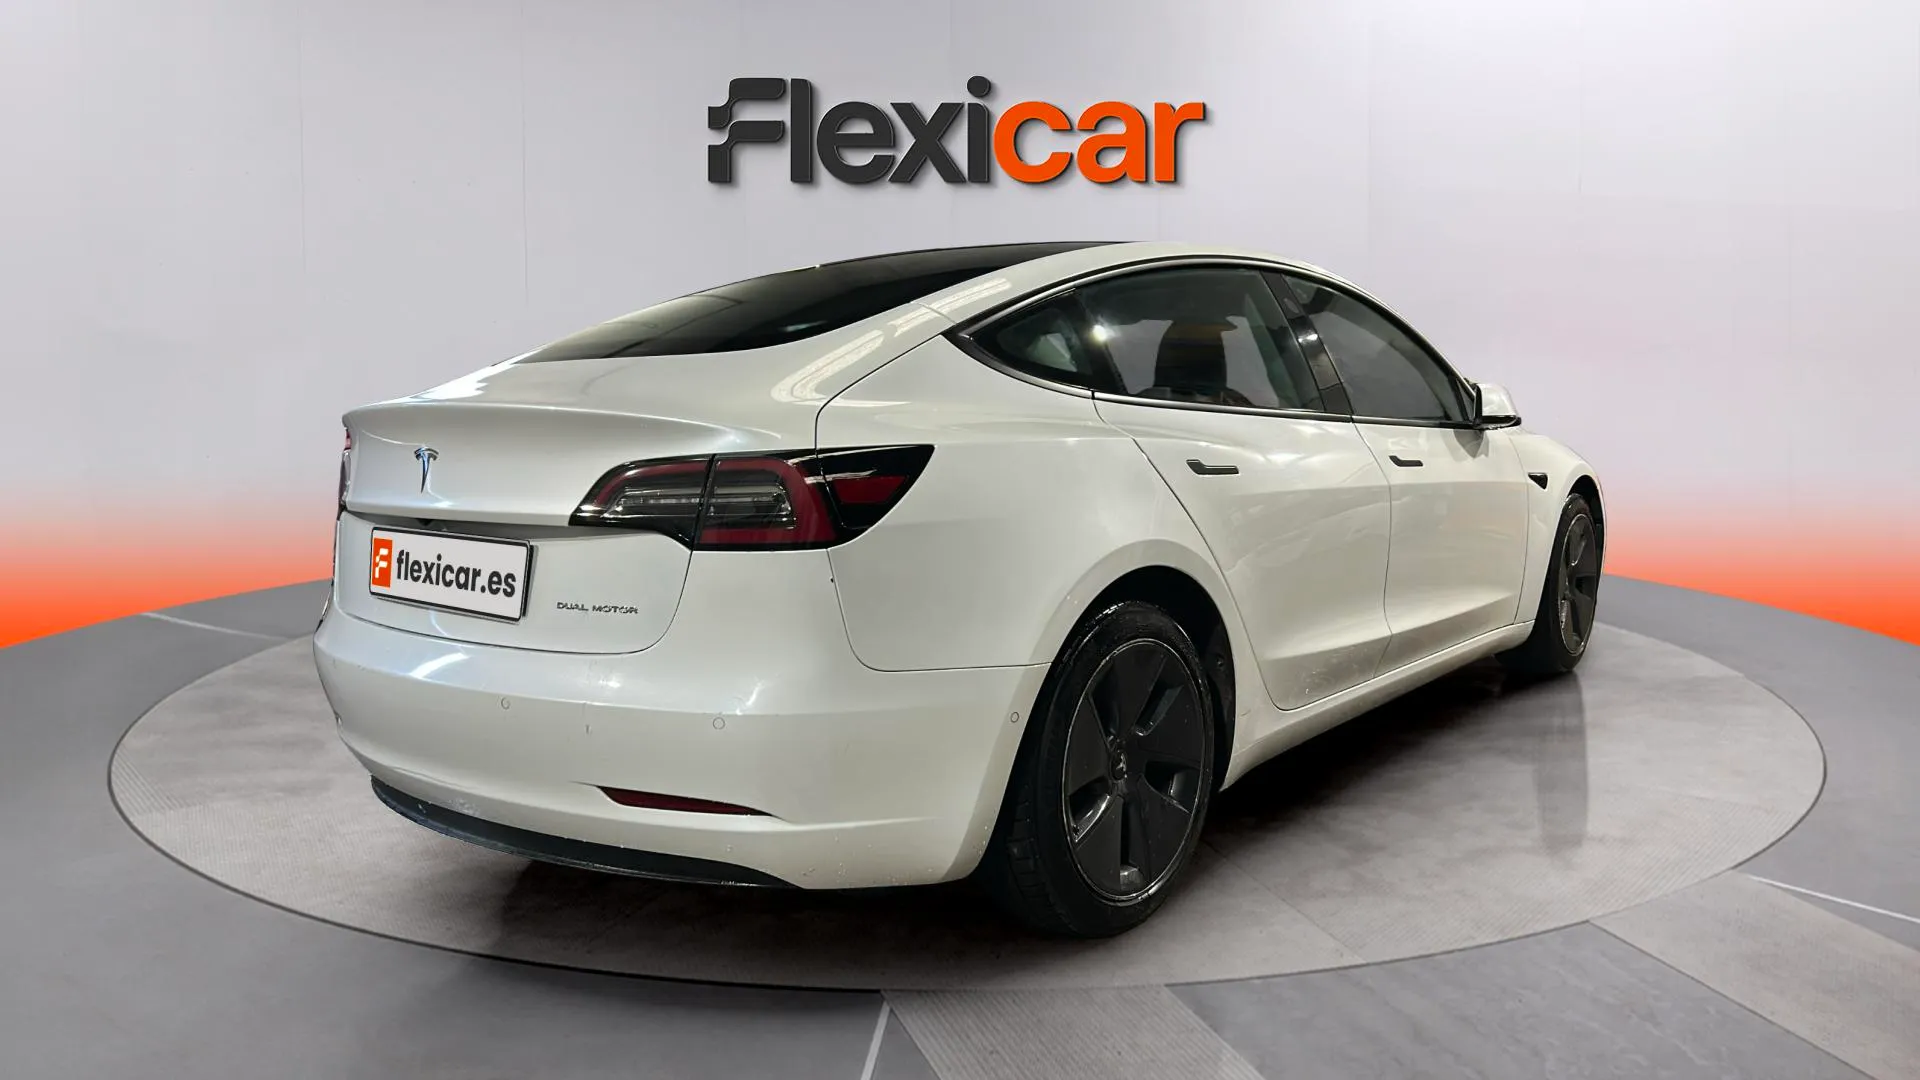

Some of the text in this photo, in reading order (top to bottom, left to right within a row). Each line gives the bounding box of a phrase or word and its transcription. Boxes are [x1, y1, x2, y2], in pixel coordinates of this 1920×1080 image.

[707, 75, 1205, 184] Flexicar
[396, 549, 517, 598] flexicar.es
[556, 601, 639, 614] DUAL MOTOR
